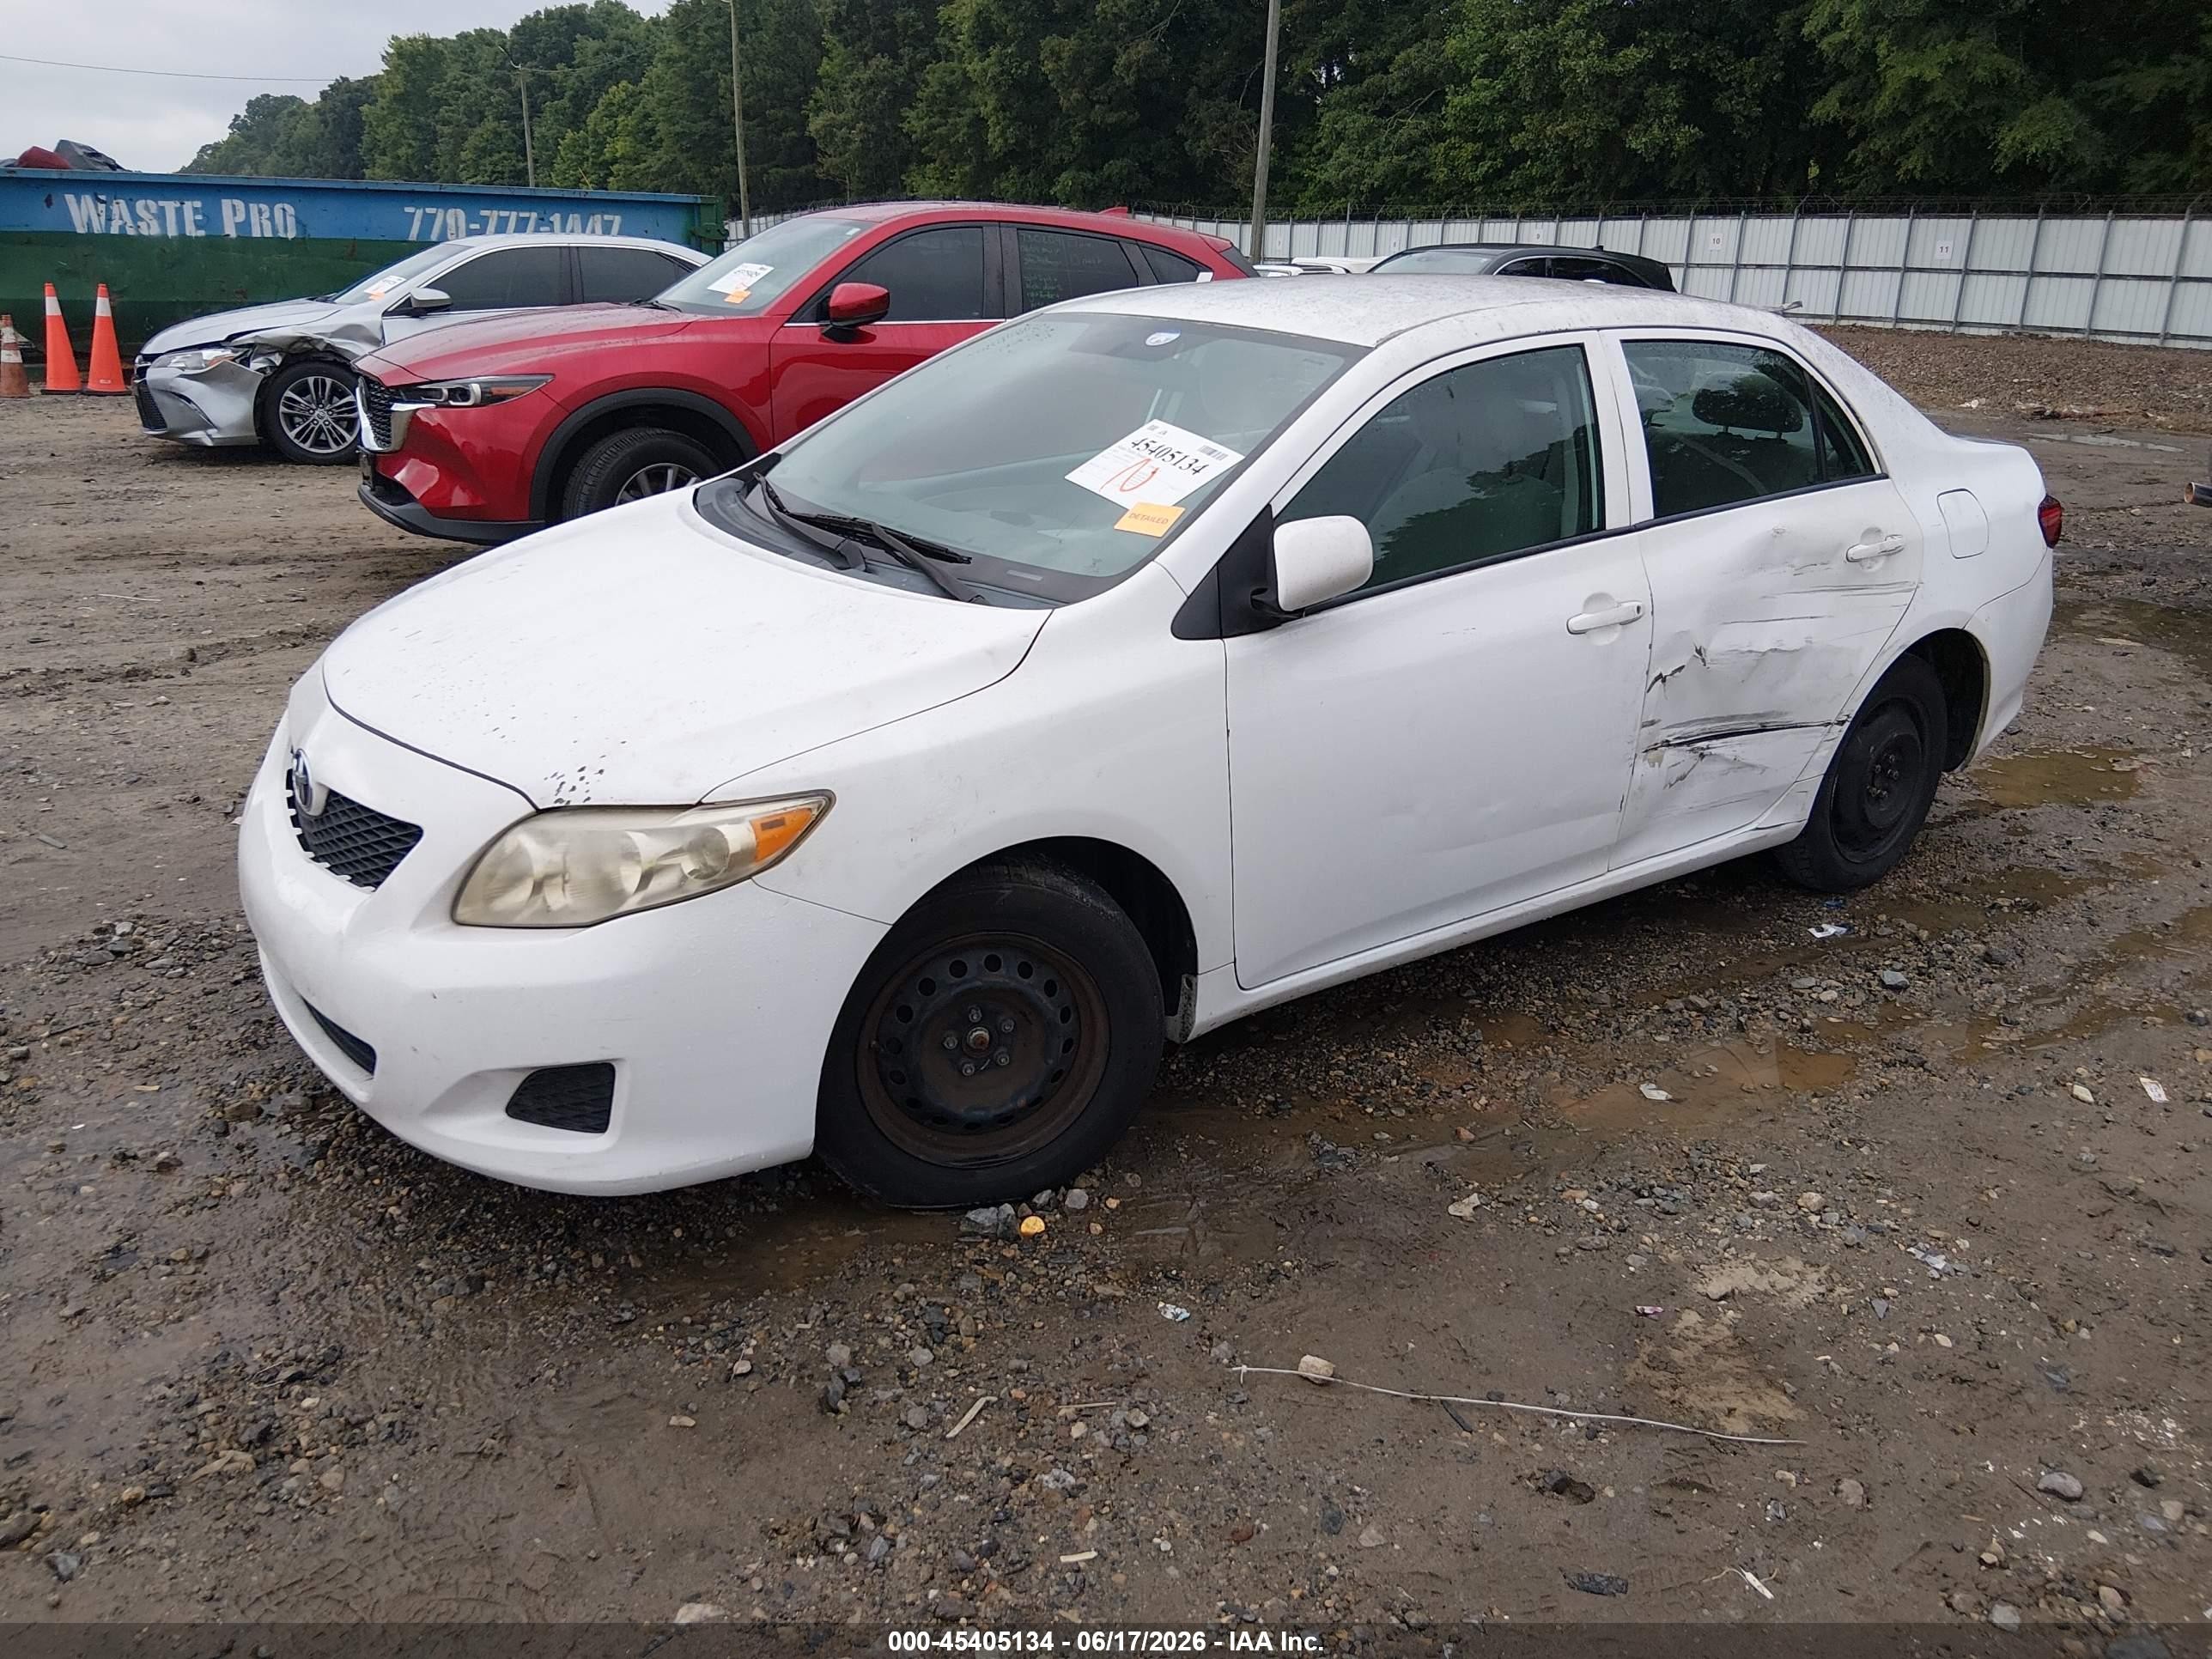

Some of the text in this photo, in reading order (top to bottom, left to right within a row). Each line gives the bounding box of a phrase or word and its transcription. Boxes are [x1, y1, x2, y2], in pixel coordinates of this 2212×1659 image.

[64, 194, 297, 240] WASTE PRO
[404, 206, 622, 241] 770-777-1447
[1131, 437, 1209, 475] 45405134
